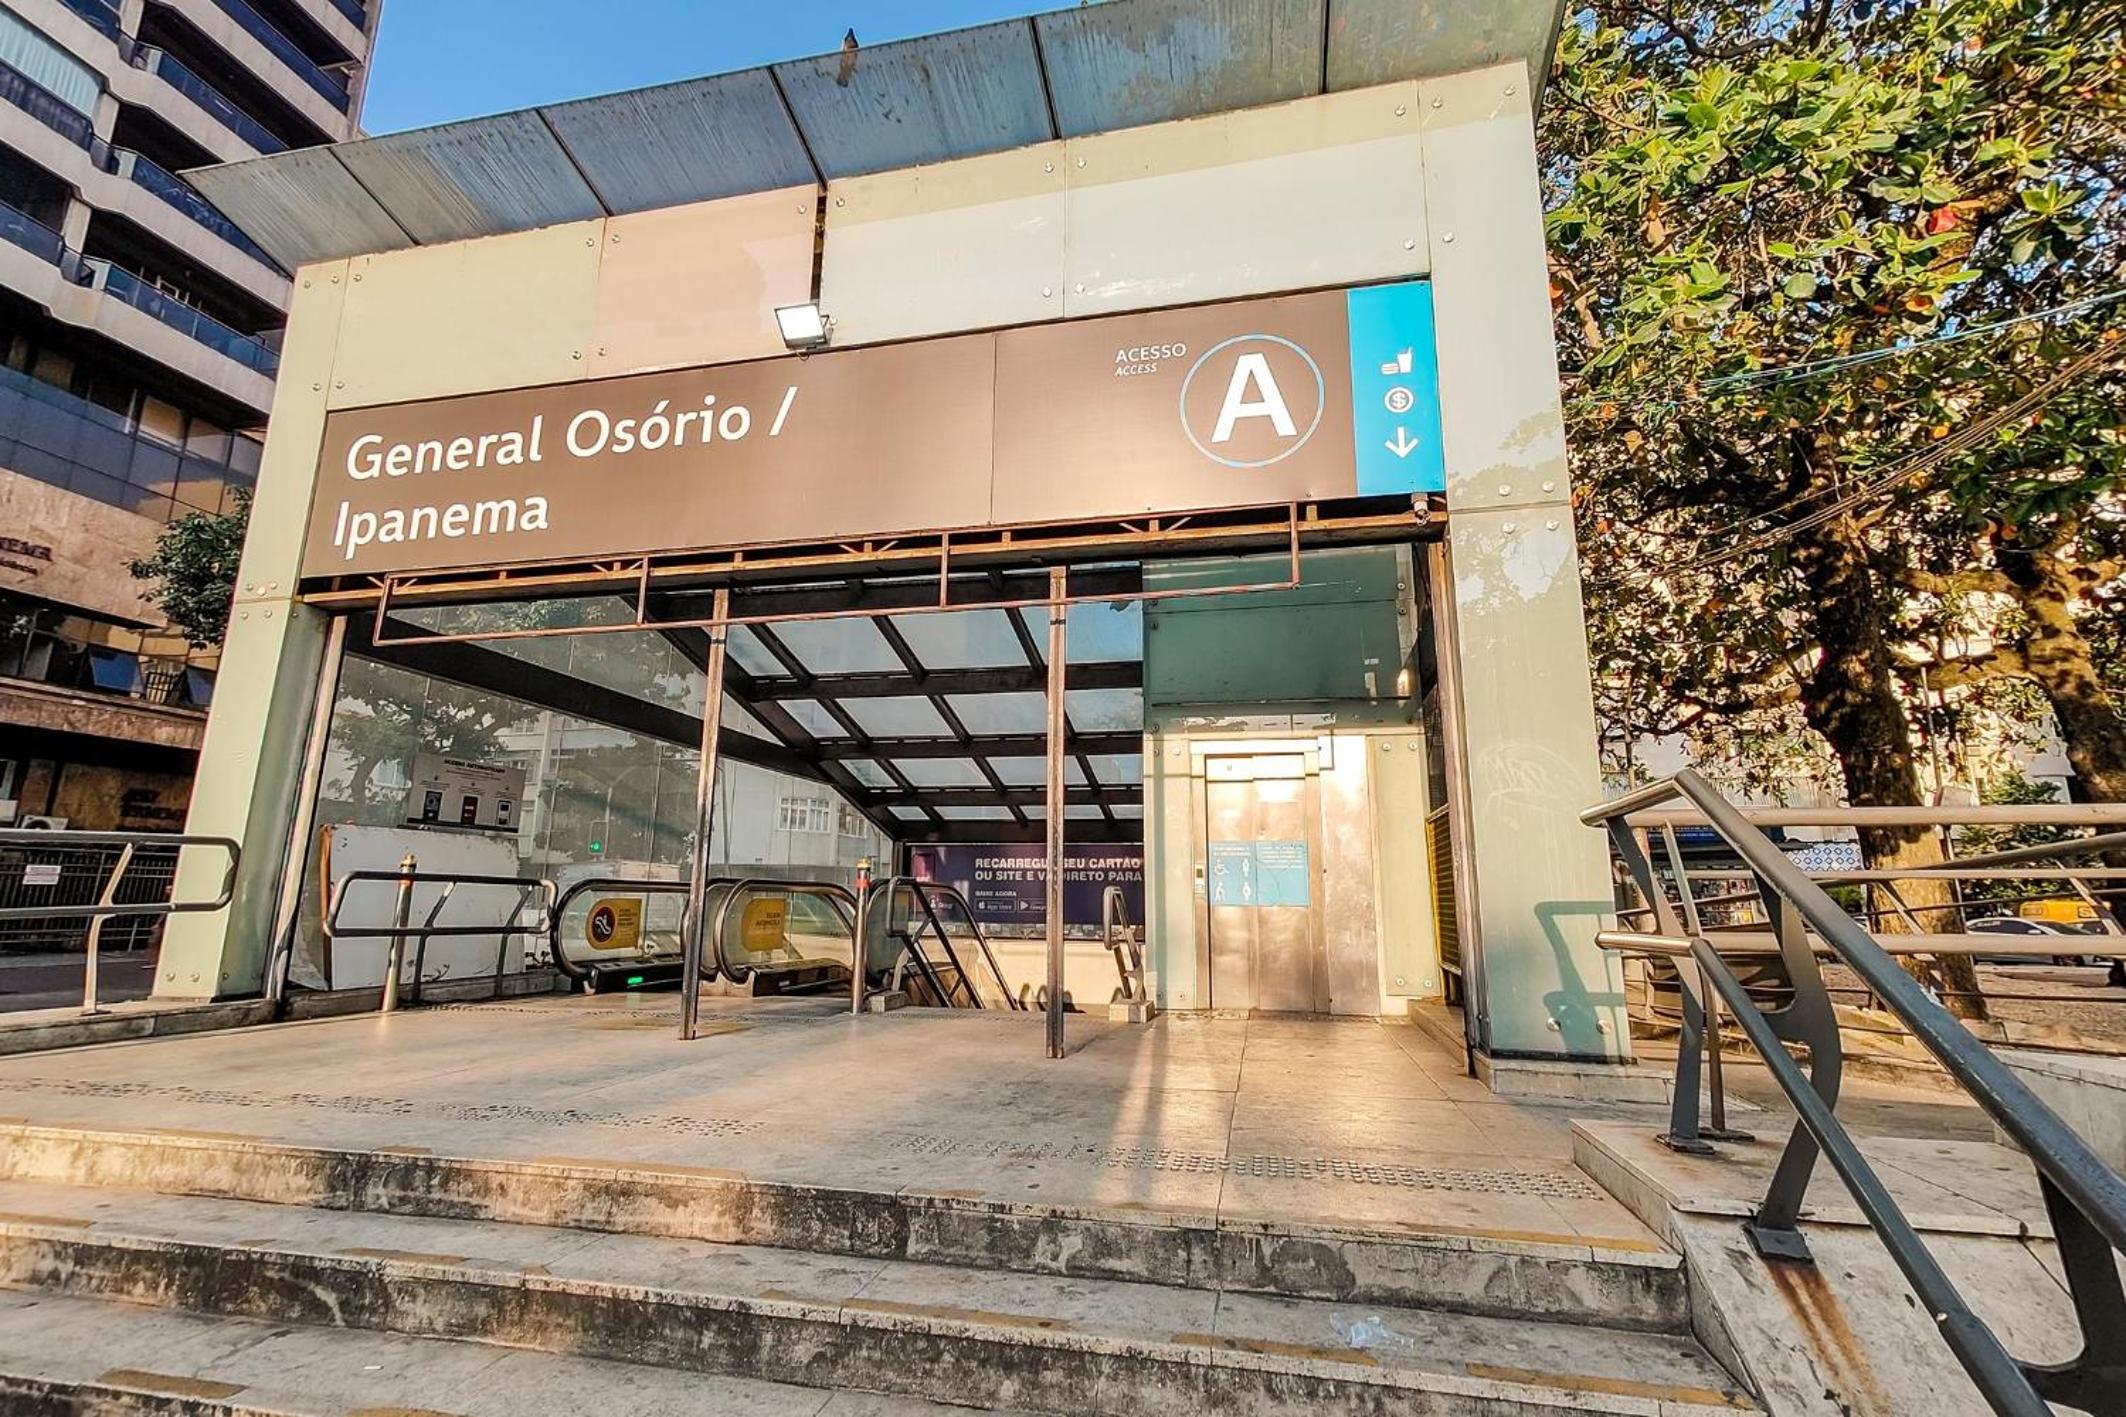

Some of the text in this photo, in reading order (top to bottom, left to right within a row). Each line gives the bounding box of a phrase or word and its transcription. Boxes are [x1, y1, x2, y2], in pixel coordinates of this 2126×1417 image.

[1115, 342, 1187, 364] ACESSO
[1114, 362, 1158, 377] ACCESS
[1210, 352, 1298, 444] A
[346, 385, 798, 480] General Osório /
[333, 495, 549, 561] Ipanema
[975, 857, 1048, 869] RECARREGU
[1089, 856, 1141, 869] CARTÃO
[975, 870, 993, 881] OU
[996, 870, 1022, 881] SITE
[1027, 870, 1035, 881] E
[1108, 870, 1143, 881] PARA
